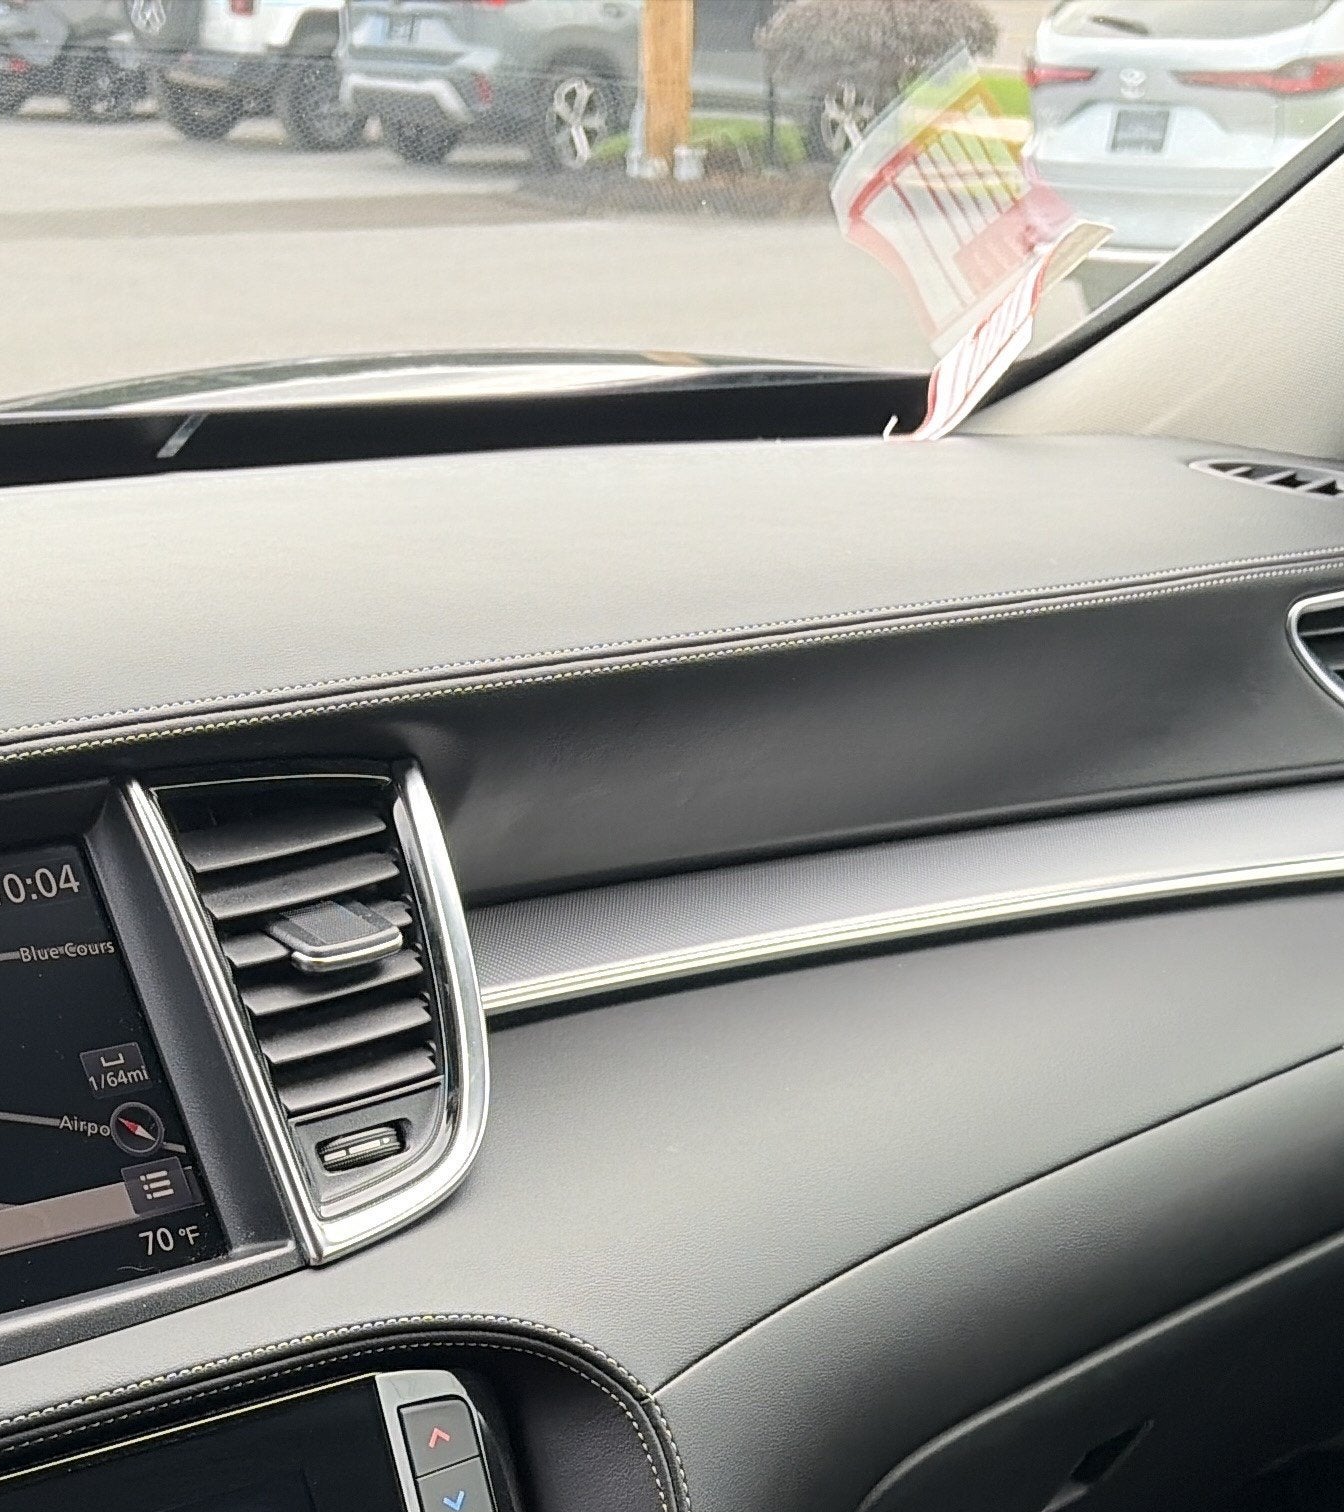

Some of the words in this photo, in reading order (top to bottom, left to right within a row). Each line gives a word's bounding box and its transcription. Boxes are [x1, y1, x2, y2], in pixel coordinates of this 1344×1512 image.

[19, 945, 60, 963] Blue
[64, 940, 115, 958] Cours
[88, 1065, 150, 1091] 1/64mi
[59, 1115, 110, 1137] Airpo
[138, 1227, 174, 1256] 70
